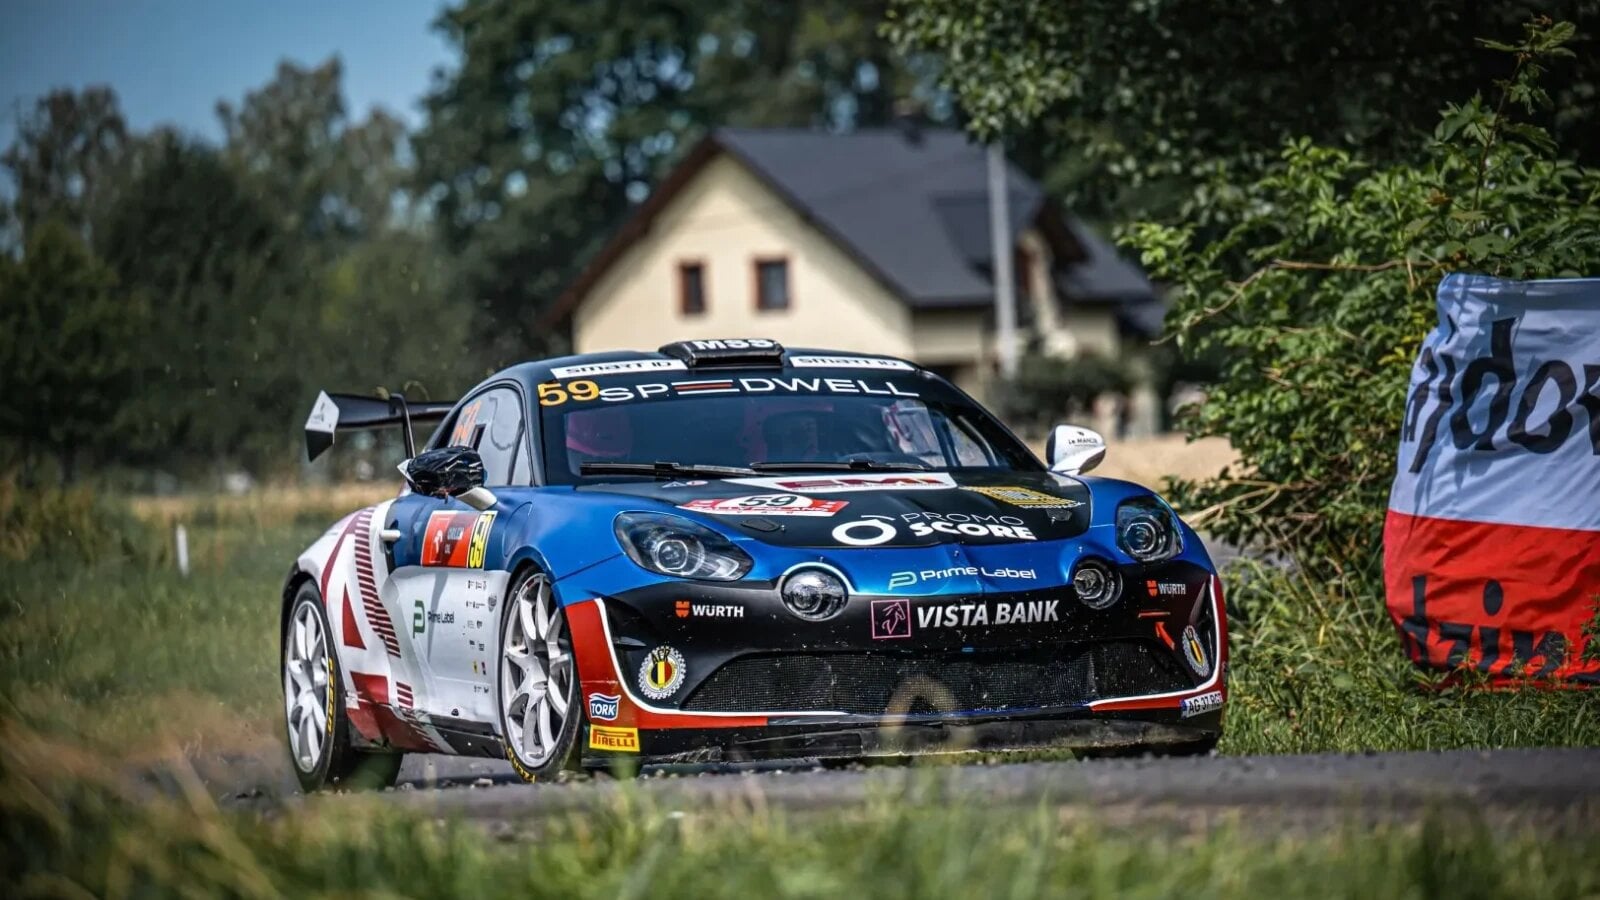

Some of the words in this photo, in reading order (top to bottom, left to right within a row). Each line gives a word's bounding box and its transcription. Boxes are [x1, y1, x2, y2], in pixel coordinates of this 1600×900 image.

[691, 339, 774, 350] MSS
[537, 380, 599, 407] 59
[739, 494, 798, 507] 59
[901, 512, 1025, 526] PROMO
[909, 521, 1037, 541] SCORE
[920, 566, 978, 580] Prime
[981, 567, 1037, 580] Label
[692, 604, 744, 618] WÜRTH
[917, 603, 989, 628] VISTA
[995, 600, 1060, 625] BANK
[591, 702, 615, 716] TORK
[592, 728, 635, 748] PIRELLI
